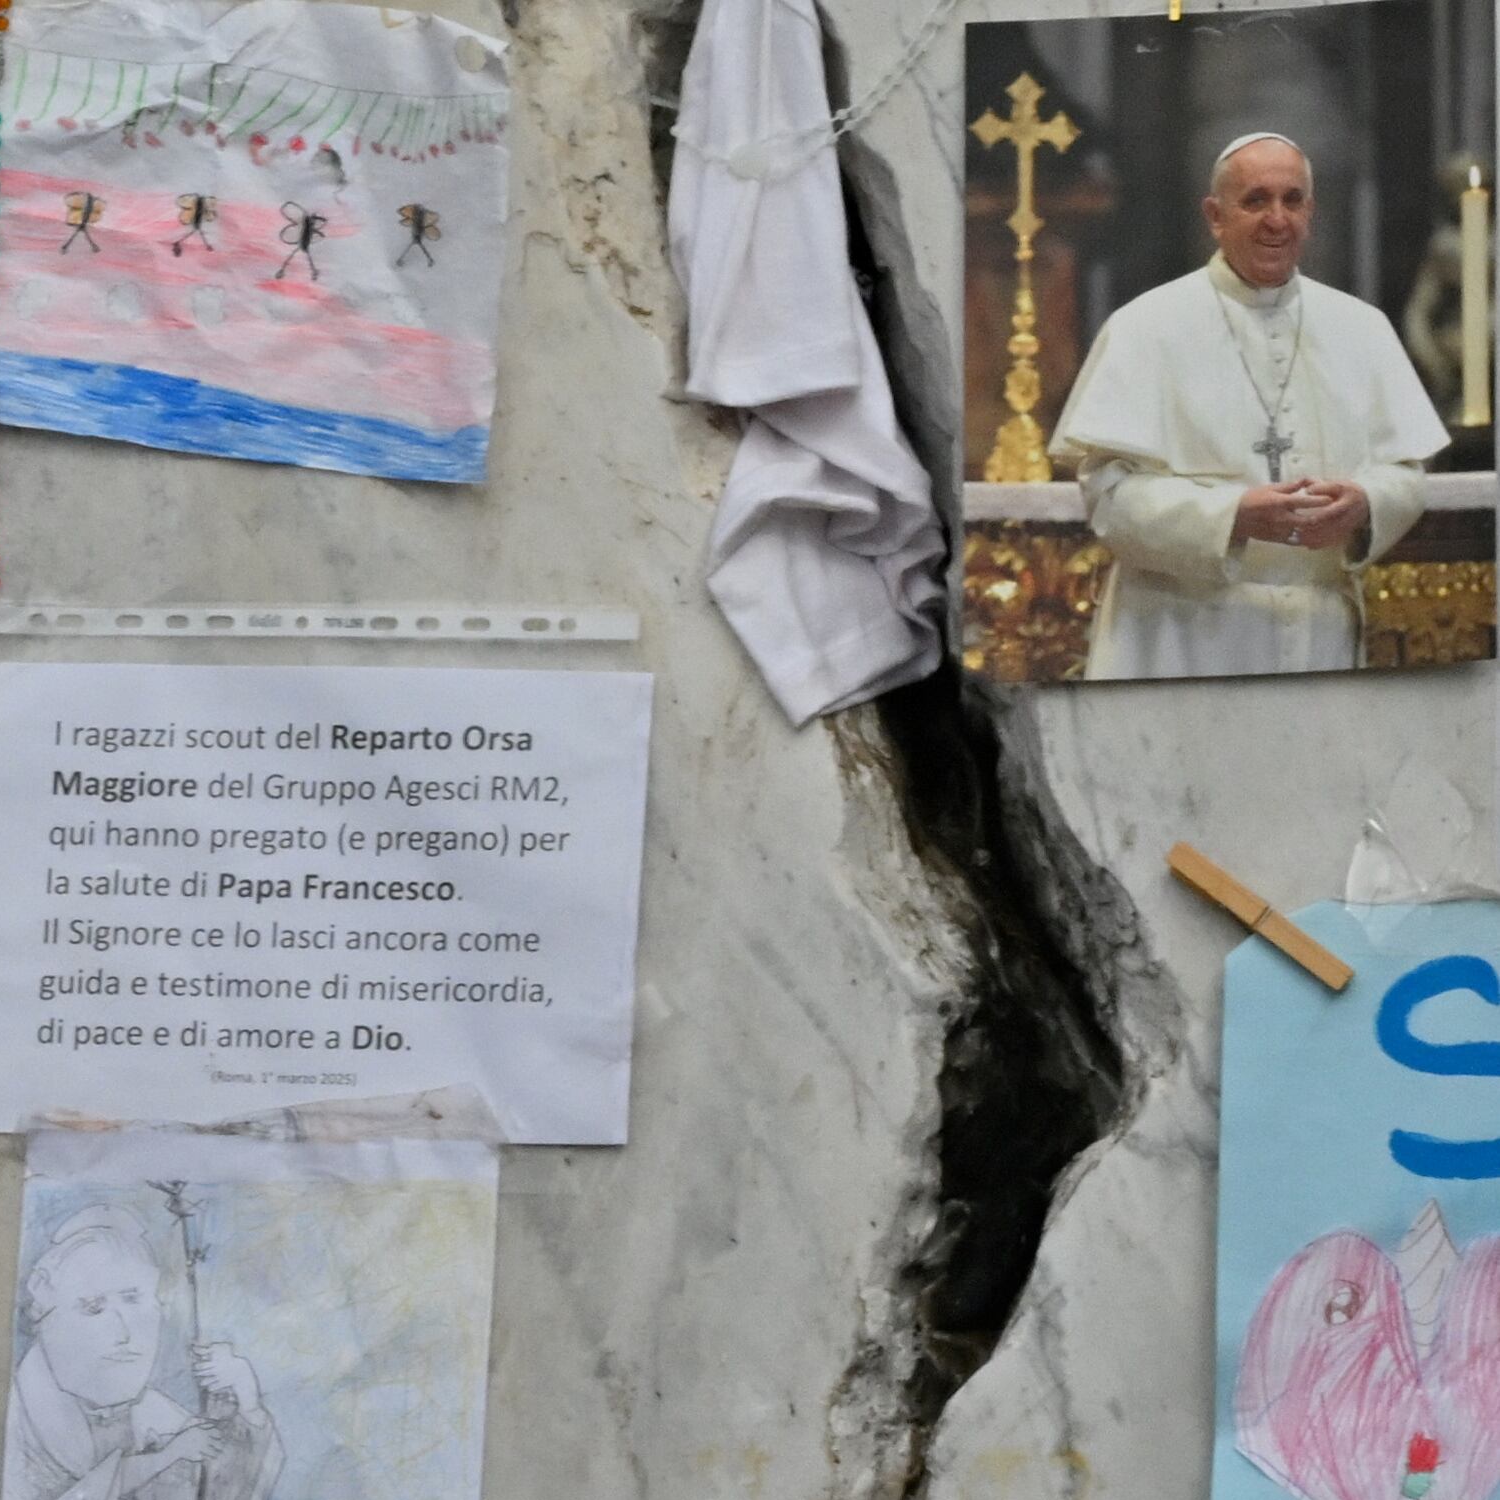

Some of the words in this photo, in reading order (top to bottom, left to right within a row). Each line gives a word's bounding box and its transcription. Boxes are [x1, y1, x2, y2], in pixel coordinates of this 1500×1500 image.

[54, 722, 62, 748] I
[72, 723, 176, 752] ragazzi
[184, 725, 266, 750] scout
[274, 723, 321, 750] del
[331, 725, 454, 758] Reparto
[461, 727, 534, 752] Orsa
[52, 771, 198, 804] Maggiore
[207, 772, 255, 800] del
[262, 775, 376, 808] Gruppo
[384, 775, 481, 808] Agesci
[491, 777, 570, 807] RM2,
[48, 822, 96, 854] qui
[106, 822, 200, 849] hanno
[209, 825, 328, 858] pregato
[337, 823, 365, 858] (e
[374, 825, 510, 859] pregano)
[519, 828, 571, 858] per
[46, 868, 71, 897] la
[79, 868, 171, 898] salute
[179, 870, 209, 899] di
[217, 873, 293, 907] Papa
[302, 875, 465, 903] Francesco.
[42, 918, 59, 947] Il
[68, 918, 181, 953] Signore
[191, 926, 225, 950] ce
[233, 922, 263, 950] lo
[271, 922, 336, 952] lasci
[344, 928, 449, 954] ancora
[457, 931, 540, 955] come
[38, 967, 120, 1002] guida
[129, 976, 148, 997] e
[157, 970, 311, 1002] testimone
[321, 972, 350, 1002] di
[358, 975, 555, 1008] misericordia,
[37, 1017, 66, 1047] di
[73, 1022, 144, 1050] pace
[152, 1026, 170, 1047] e
[179, 1020, 208, 1048] di
[216, 1026, 315, 1050] amore
[324, 1030, 341, 1050] a
[351, 1023, 413, 1053] Dio.
